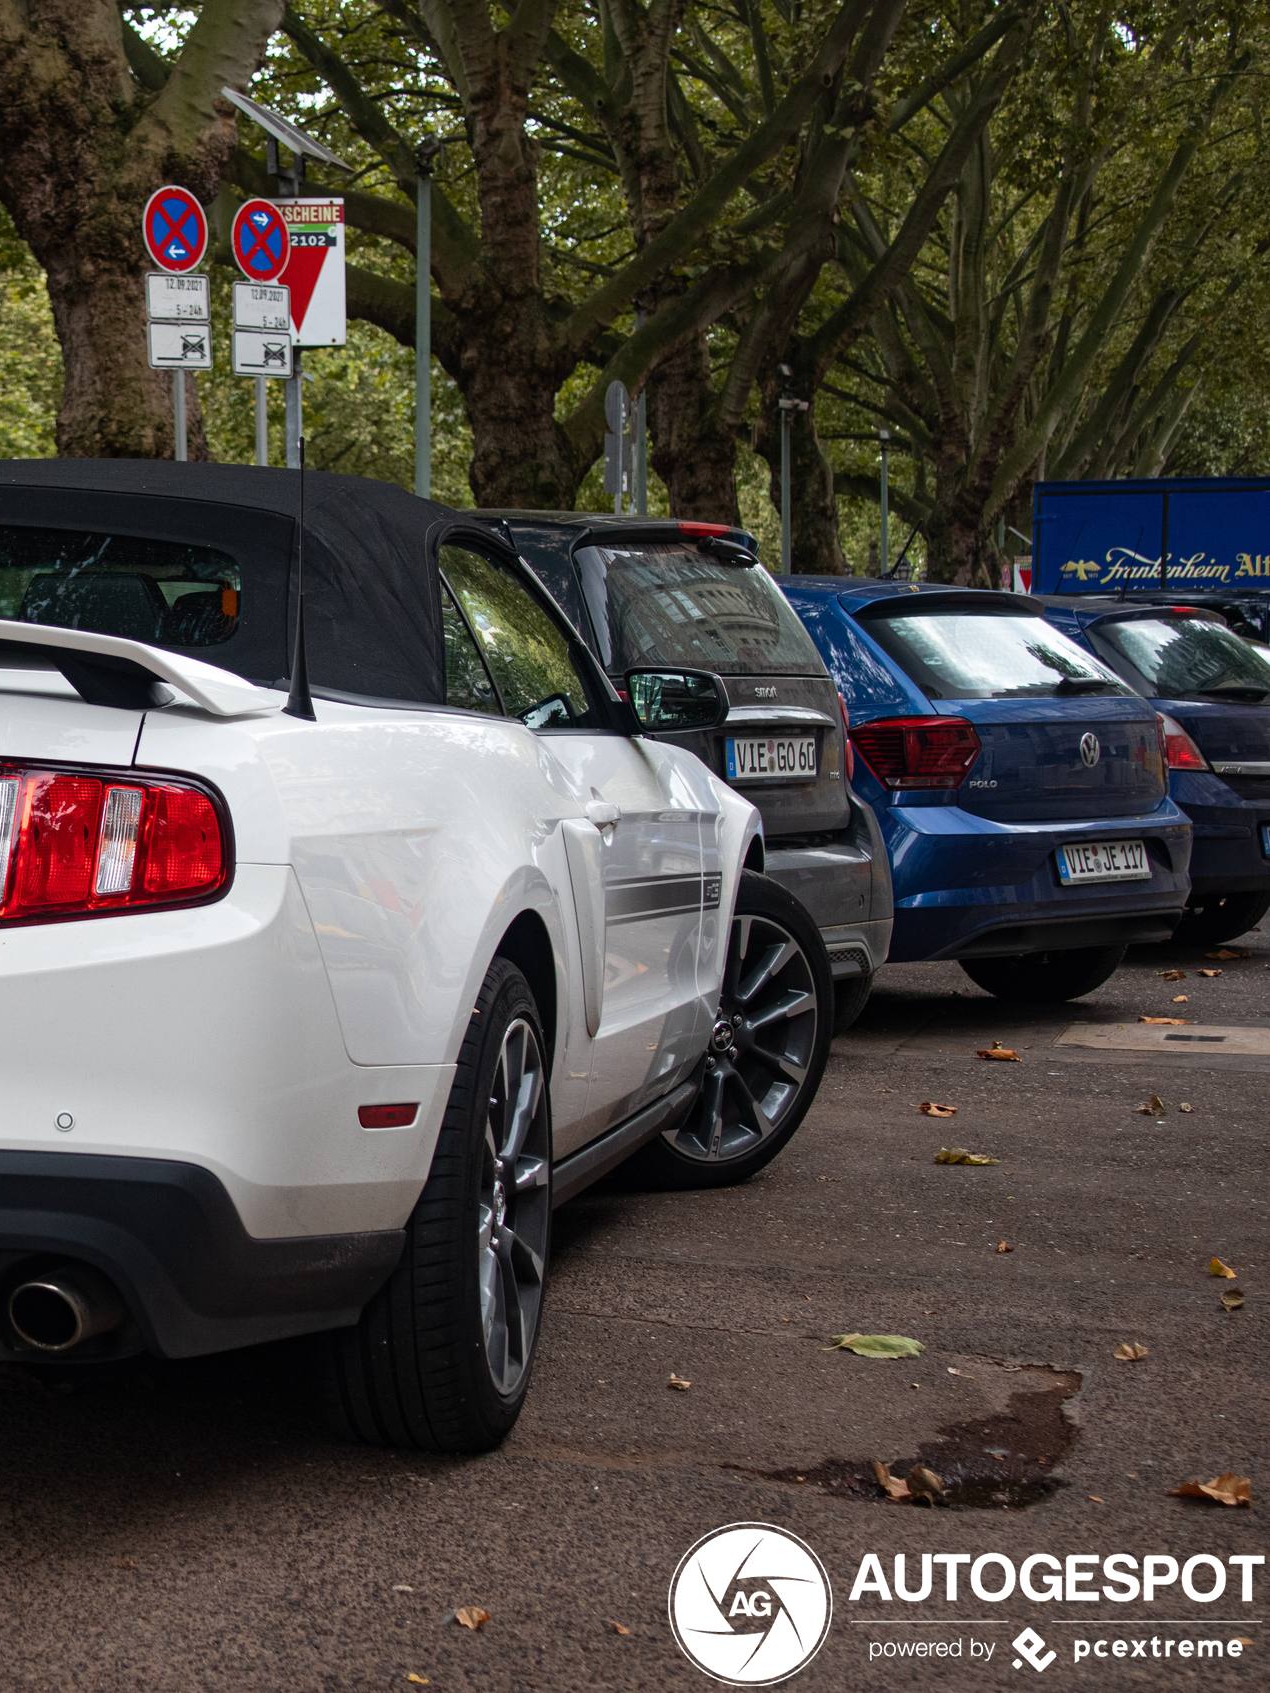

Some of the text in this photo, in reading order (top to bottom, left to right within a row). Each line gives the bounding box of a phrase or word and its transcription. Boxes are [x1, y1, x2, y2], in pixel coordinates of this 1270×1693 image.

[290, 235, 326, 246] 2102
[165, 278, 203, 291] 12.09.2021
[251, 289, 284, 302] 12.09.2021
[1100, 547, 1231, 584] Frankenheim
[754, 685, 778, 698] smart
[736, 742, 768, 773] VIE
[777, 741, 796, 772] GO
[969, 779, 998, 789] POLO
[1065, 847, 1095, 874] VIE
[1102, 845, 1121, 871] JE
[1120, 843, 1143, 869] 117
